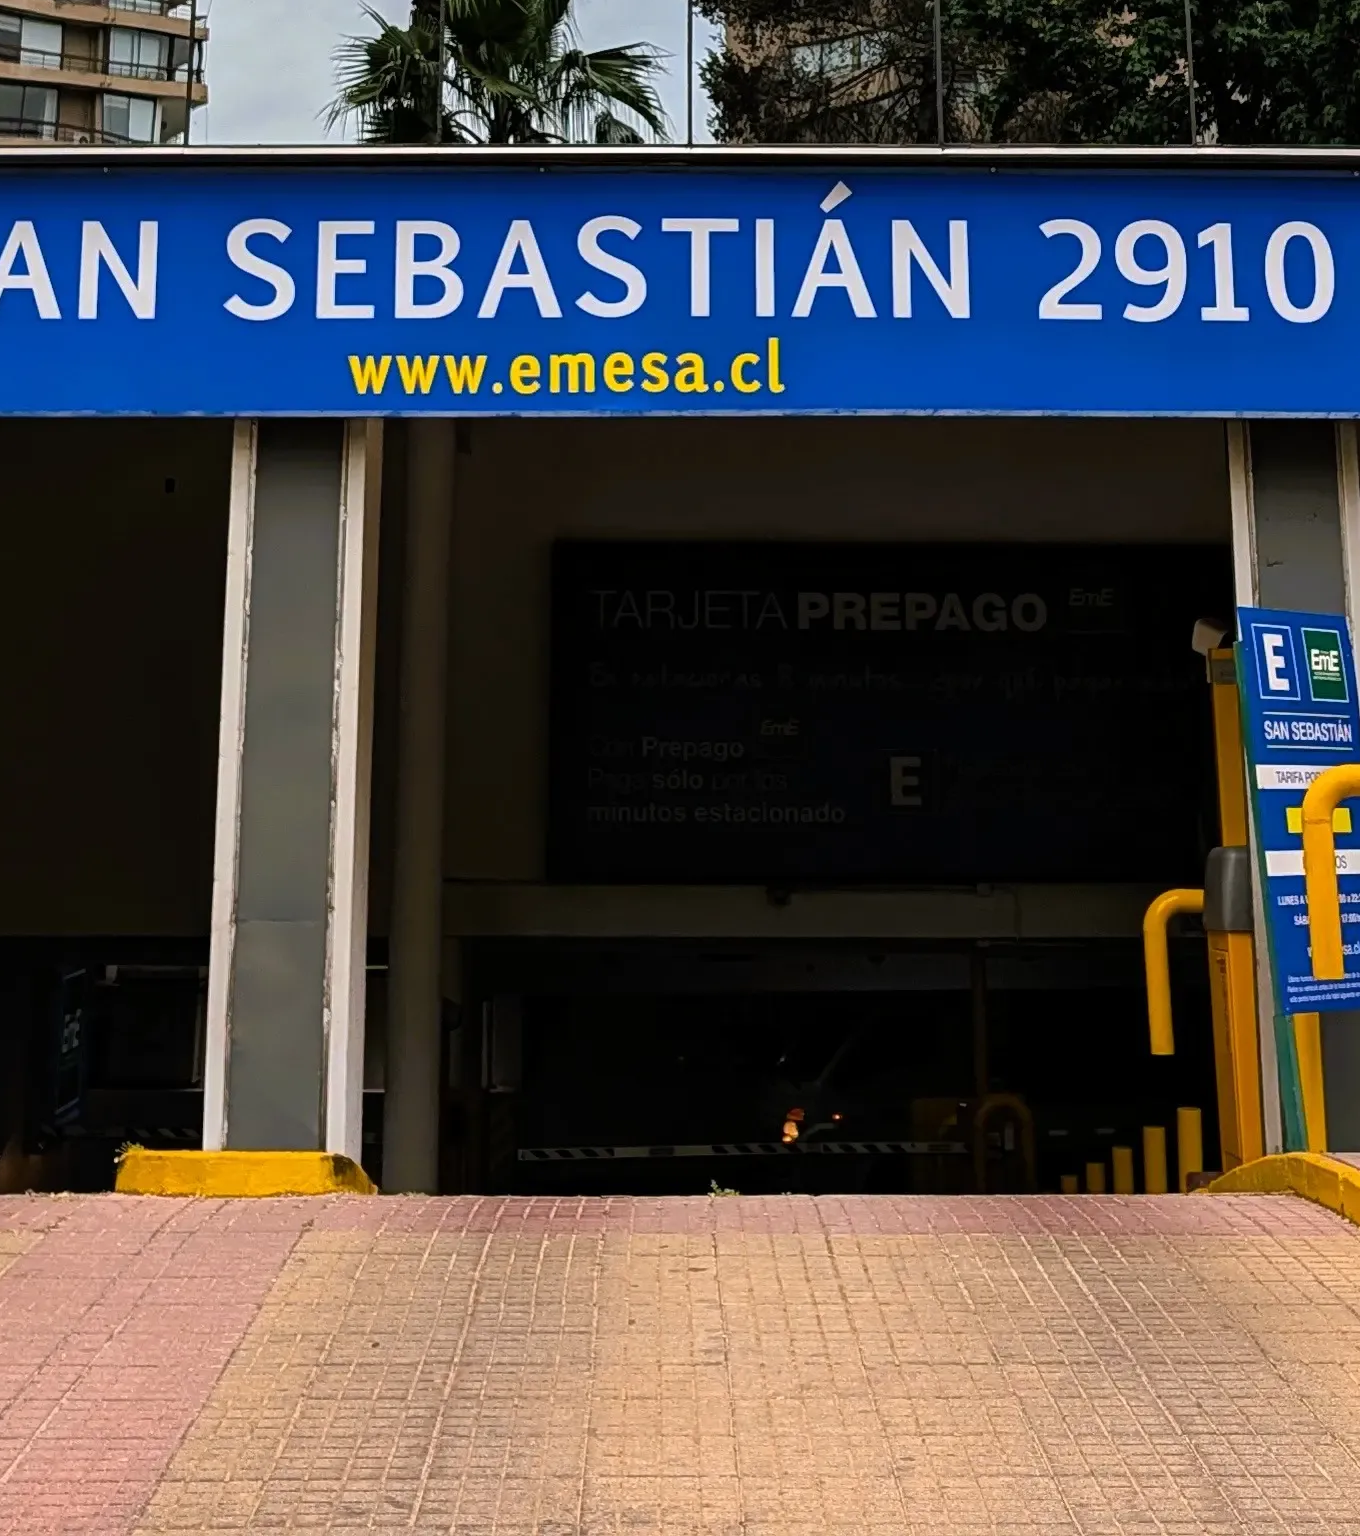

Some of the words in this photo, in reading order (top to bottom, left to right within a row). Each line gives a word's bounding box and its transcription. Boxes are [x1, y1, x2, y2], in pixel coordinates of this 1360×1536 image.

[224, 181, 970, 321] SEBASTIÁN
[1039, 219, 1335, 323] 2910
[349, 338, 785, 394] www.emesa.cl
[588, 589, 789, 630] TARJETA
[796, 591, 1048, 632] PREPAGO
[1262, 633, 1290, 691] E
[640, 735, 745, 762] Prepago
[1264, 720, 1289, 741] SAN
[1290, 719, 1353, 743] SEBASTIÁN
[651, 768, 704, 790] sólo
[889, 755, 923, 807] E
[1275, 770, 1304, 784] TARIFA
[586, 801, 687, 824] minutos
[693, 801, 847, 824] estacionado
